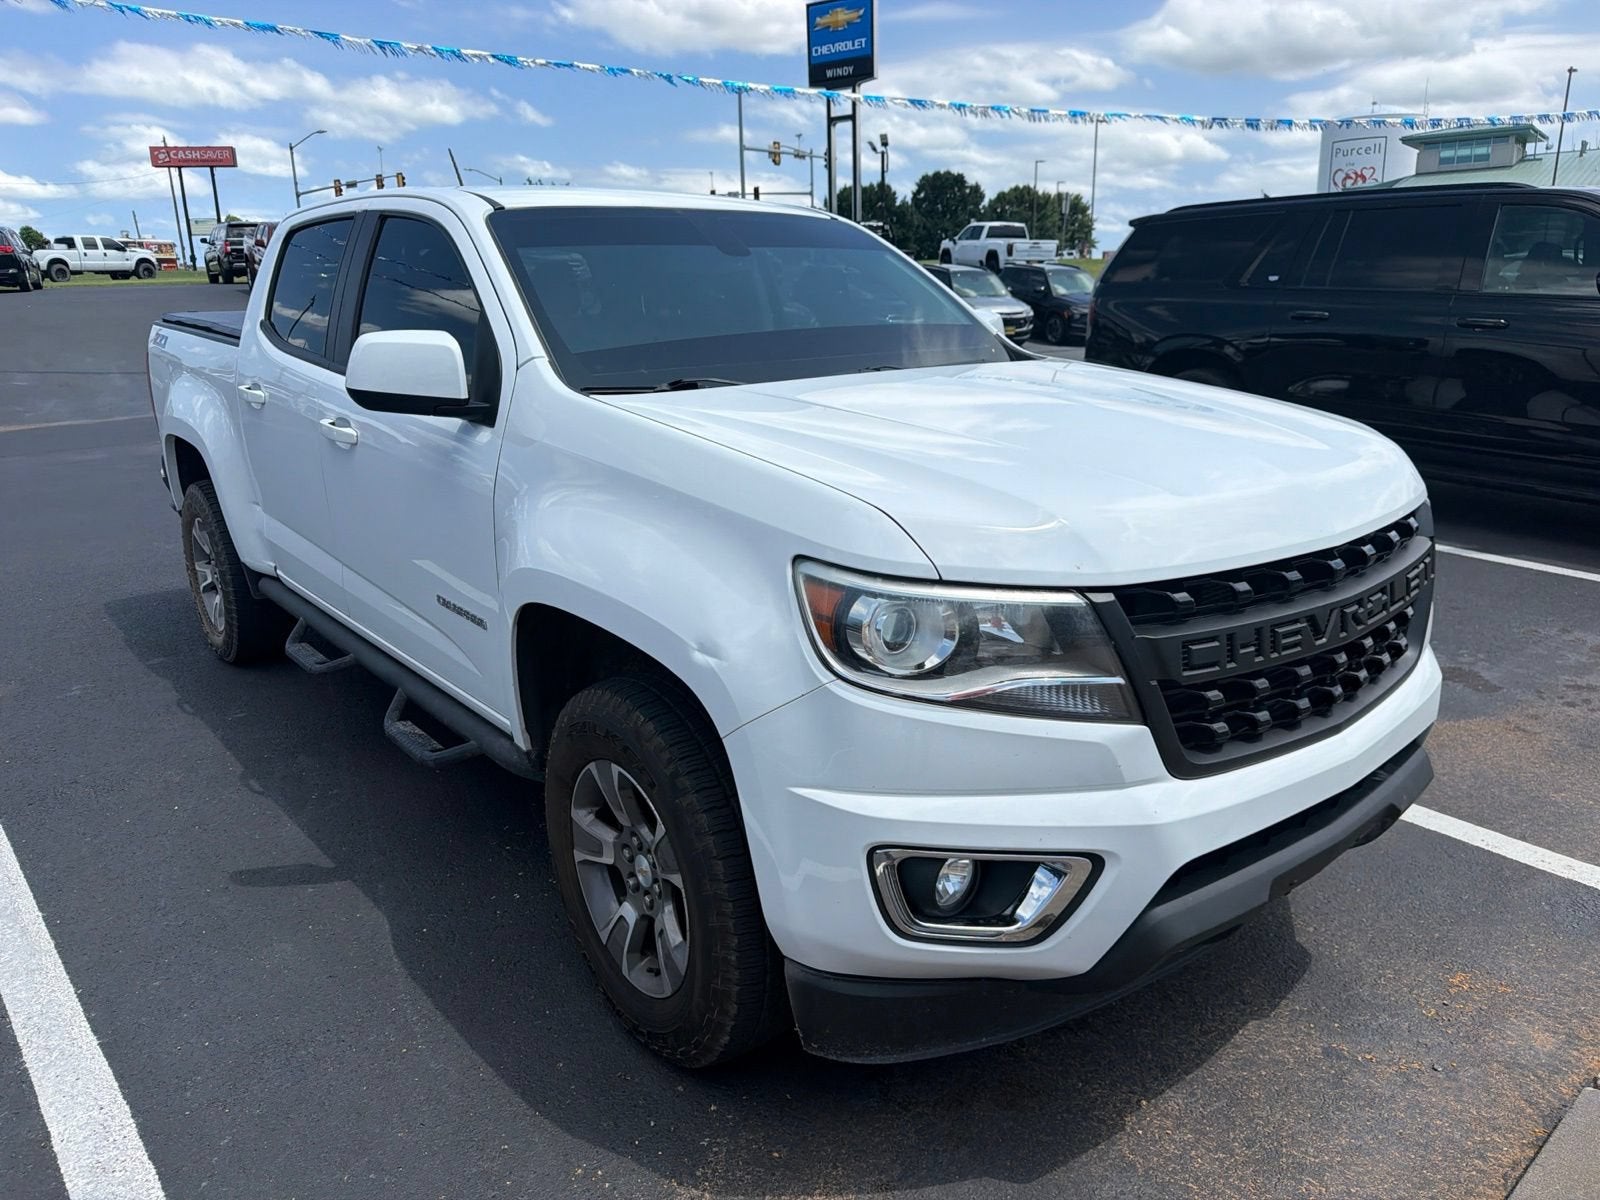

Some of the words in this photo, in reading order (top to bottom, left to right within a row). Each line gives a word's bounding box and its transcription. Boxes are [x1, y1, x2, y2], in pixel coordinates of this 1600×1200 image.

[812, 38, 867, 57] CHEVROLET
[826, 66, 854, 78] WINDY
[1335, 143, 1382, 158] Purcell
[1181, 556, 1435, 676] CHEVROLET
